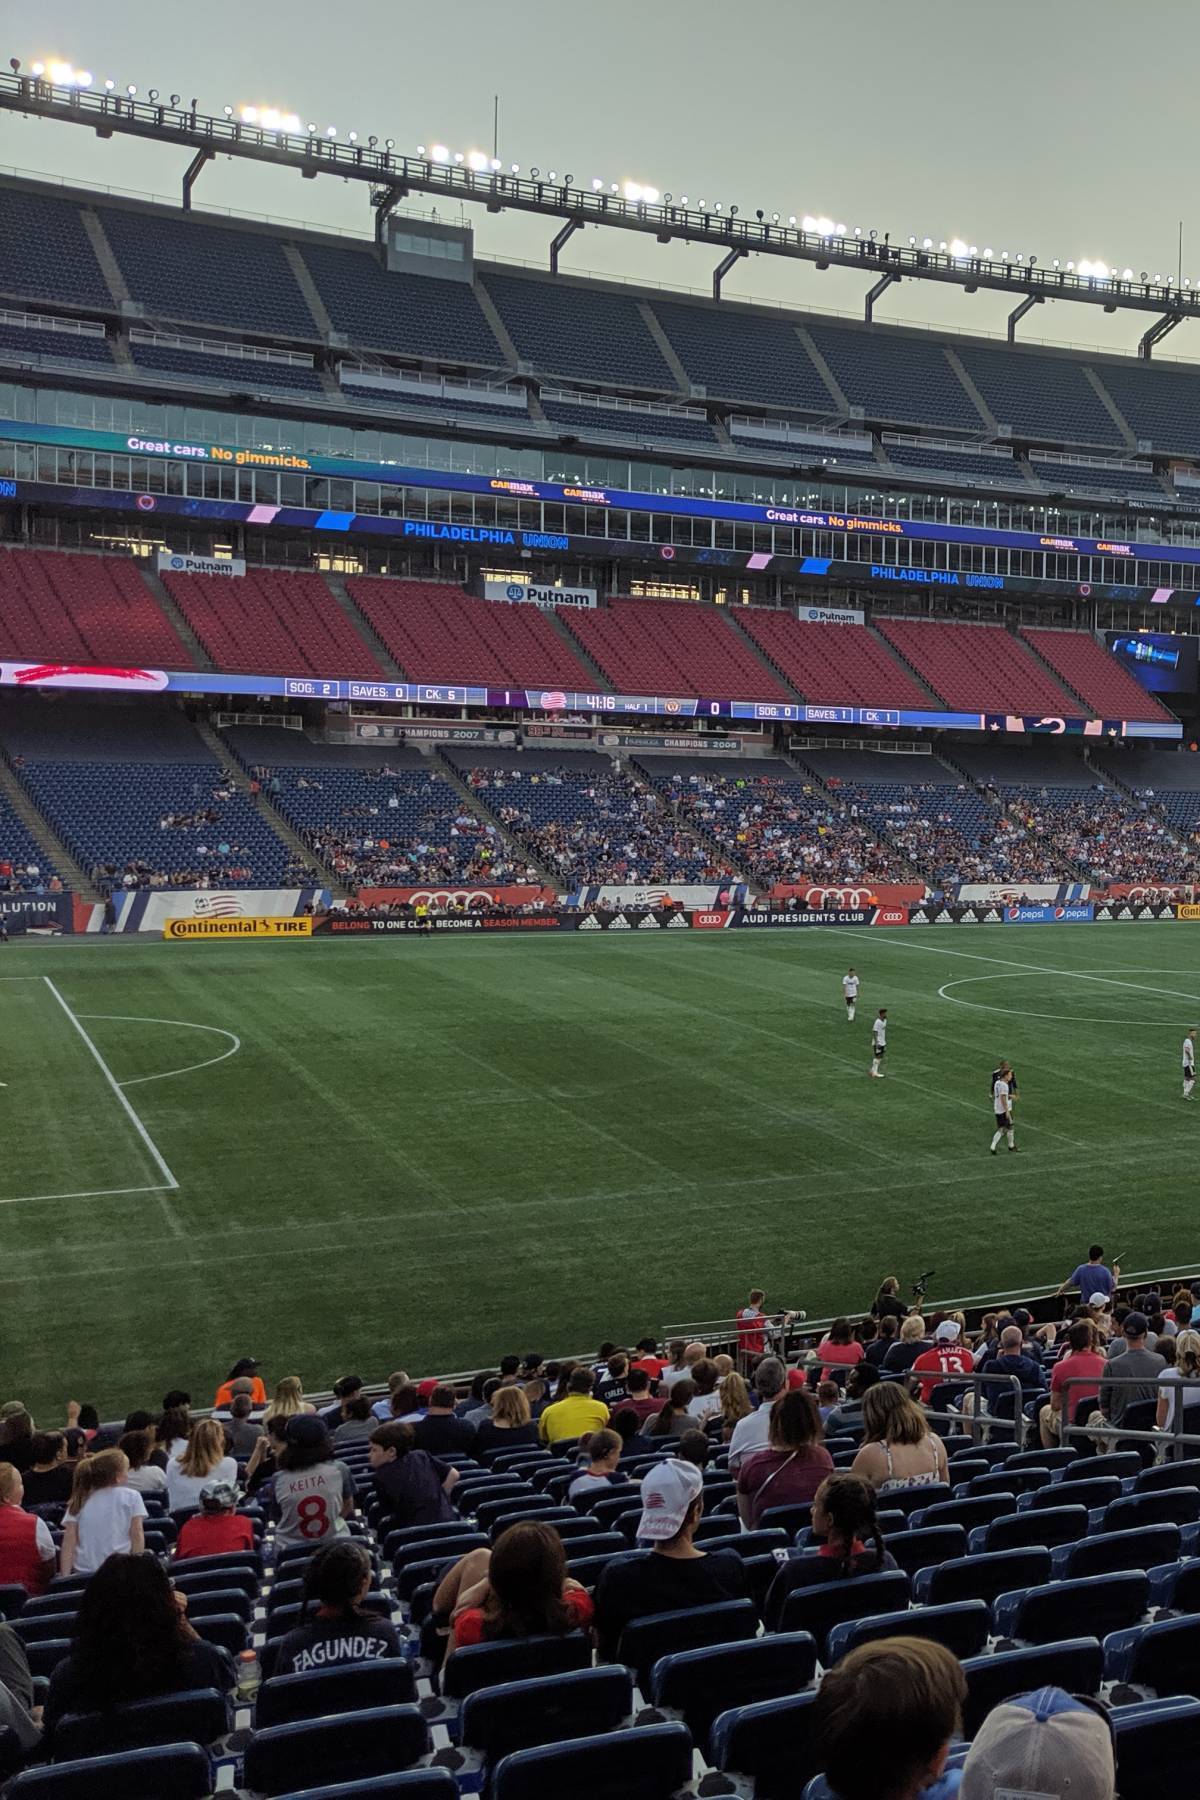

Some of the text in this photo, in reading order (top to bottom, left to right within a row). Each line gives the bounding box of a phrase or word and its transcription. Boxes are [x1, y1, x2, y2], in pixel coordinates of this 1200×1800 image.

[128, 438, 311, 469] Great cars. No gimmicks.
[767, 510, 903, 534] Great cars. No gimmicks.
[404, 522, 568, 550] PHILADELPHIA UNION
[185, 560, 233, 574] Putnam
[871, 566, 1004, 589] PHILADELPHIA UNION
[527, 588, 589, 605] Putnam
[819, 611, 855, 622] Putnam
[290, 682, 331, 694] SOG: 2
[352, 686, 403, 697] SAVES: 0
[425, 689, 455, 700] CK: 5
[505, 692, 510, 704] 1
[586, 696, 615, 710] 41:16
[624, 703, 640, 711] HALF
[711, 702, 719, 715] 0
[758, 707, 791, 717] SOG: 0
[808, 709, 846, 719] SAVES: 1
[866, 712, 880, 721] CK:
[399, 729, 479, 739] CHAMPIONS 2007
[664, 739, 708, 748] CHAMPIONS
[0, 902, 56, 913] LUTION
[1067, 907, 1088, 918] pepsi
[742, 912, 865, 923] AUDI PRESIDENTS CLUB
[1021, 910, 1044, 920] pepsi
[170, 919, 307, 937] Continental TIRE
[332, 921, 369, 930] BELONG
[372, 920, 385, 929] TO
[387, 920, 406, 929] ONE
[436, 919, 473, 928] BECOME
[474, 918, 482, 928] A
[483, 917, 519, 927] SEASON
[521, 916, 560, 926] MEMBER.
[939, 1356, 965, 1376] 13
[289, 1475, 326, 1492] KEITA
[297, 1495, 330, 1539] 8
[292, 1636, 389, 1673] FAGUNDEZ
